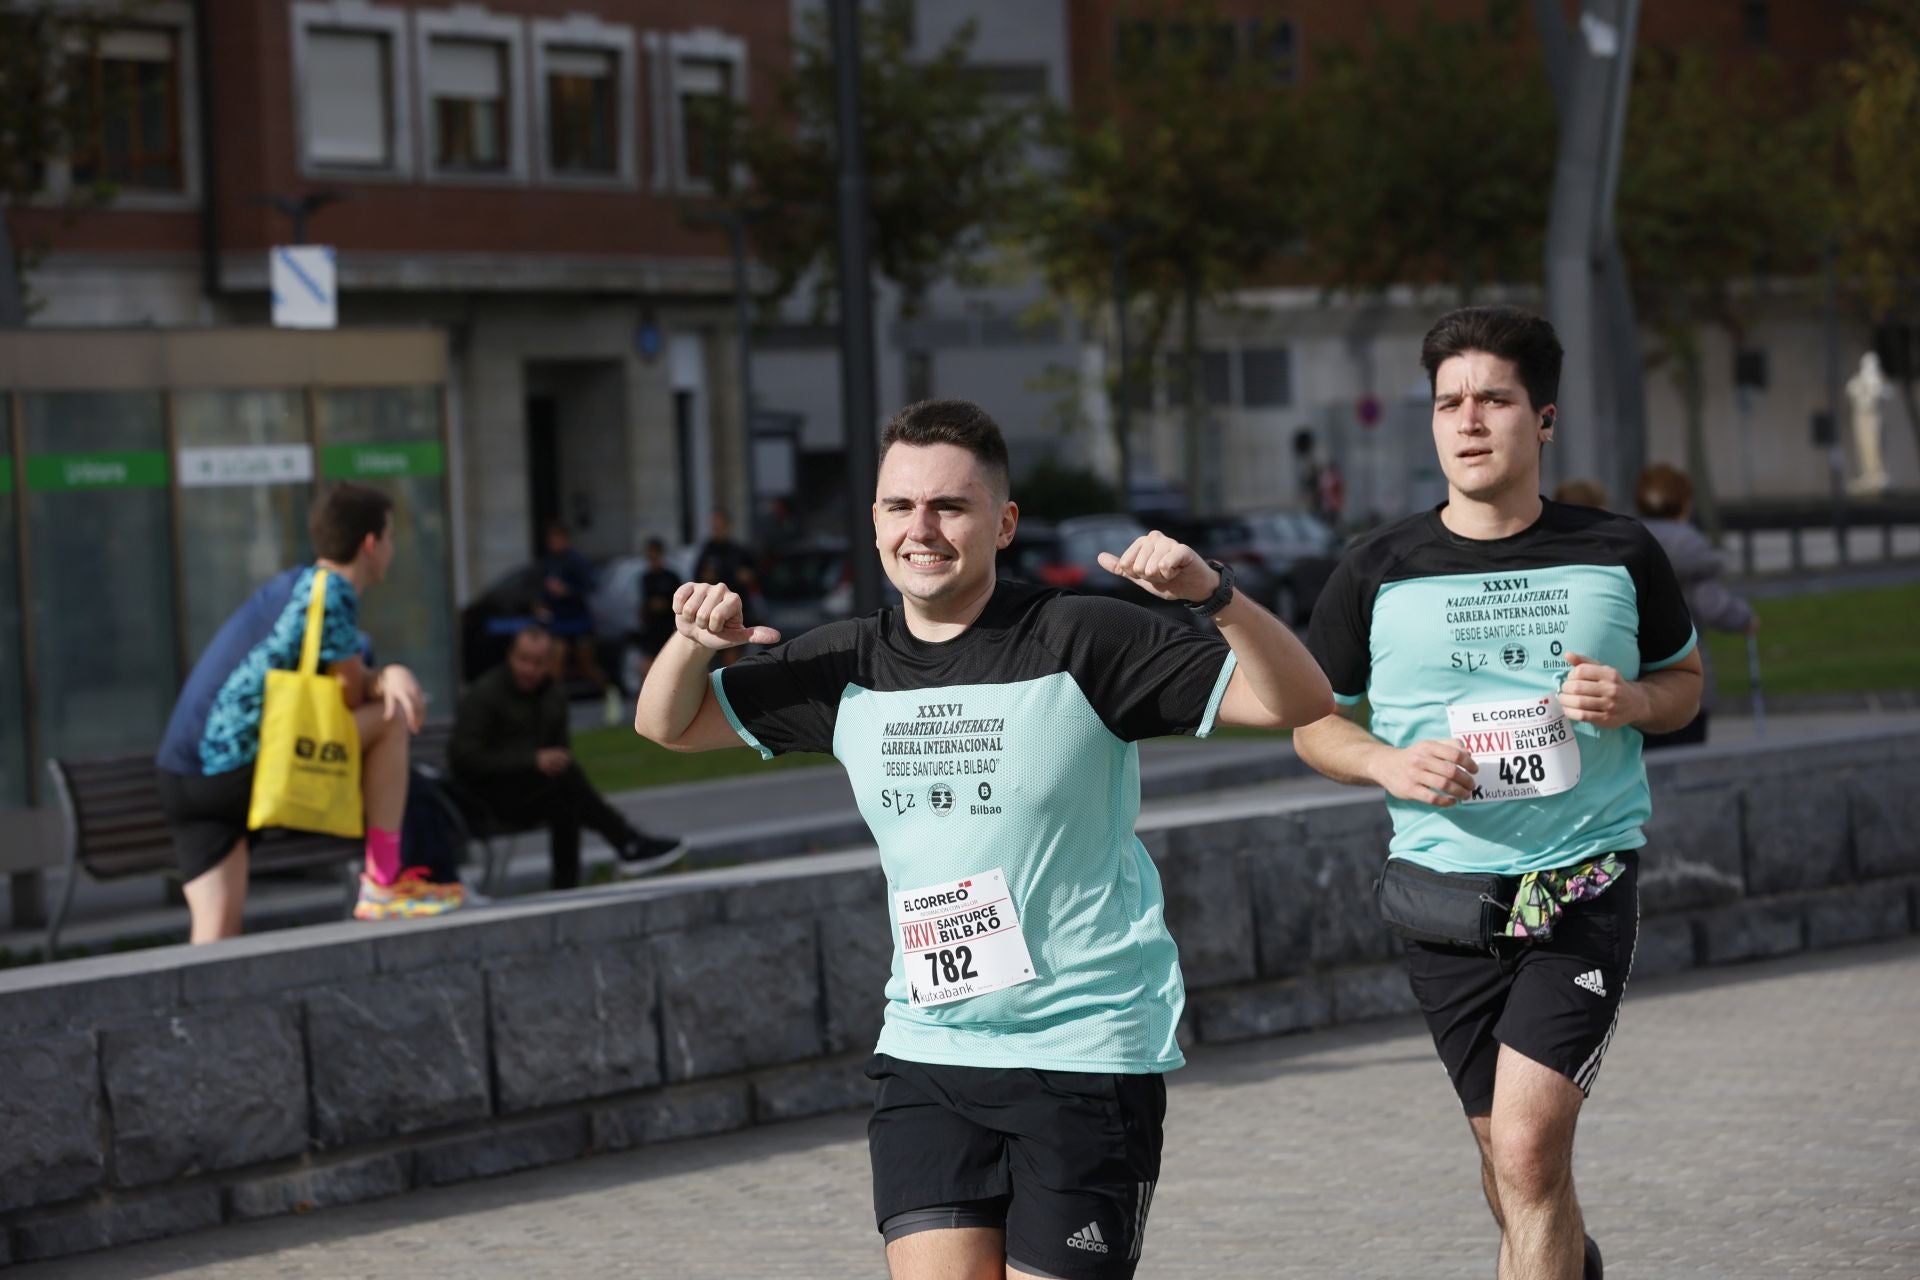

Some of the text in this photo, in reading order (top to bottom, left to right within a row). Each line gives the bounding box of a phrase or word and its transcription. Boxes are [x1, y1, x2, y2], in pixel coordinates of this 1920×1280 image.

[1483, 578, 1529, 592] XXXVI
[1446, 588, 1569, 609] NAZIOARTEKO LASTERKETA
[1446, 604, 1570, 623] CARRERA INTERNACIONAL
[1483, 623, 1525, 639] SANTURCE
[1528, 623, 1534, 635] A
[916, 703, 963, 718] XXXVI
[1472, 712, 1489, 722] EL
[1490, 706, 1546, 721] CORREO
[882, 718, 1005, 736] NAZIOARTEKO LASTERKETA
[1514, 720, 1564, 739] SANTURCE
[881, 737, 1003, 755] CARRERA INTERNACIONAL
[1462, 731, 1511, 754] XXXVI
[1516, 730, 1566, 750] BILBAO
[912, 760, 954, 776] SANTURCE
[957, 760, 962, 775] A
[1499, 754, 1545, 785] 428
[1485, 785, 1539, 799] kutxabank
[970, 805, 1002, 815] Bilbao
[903, 889, 968, 912] EL CORREO
[936, 905, 998, 930] SANTURCE
[902, 921, 937, 950] XXXVI
[939, 916, 1001, 943] BILBAO
[924, 945, 978, 987] 782
[920, 983, 974, 1002] kutxabank
[1573, 976, 1607, 998] adidas
[1066, 1237, 1109, 1254] adidas
